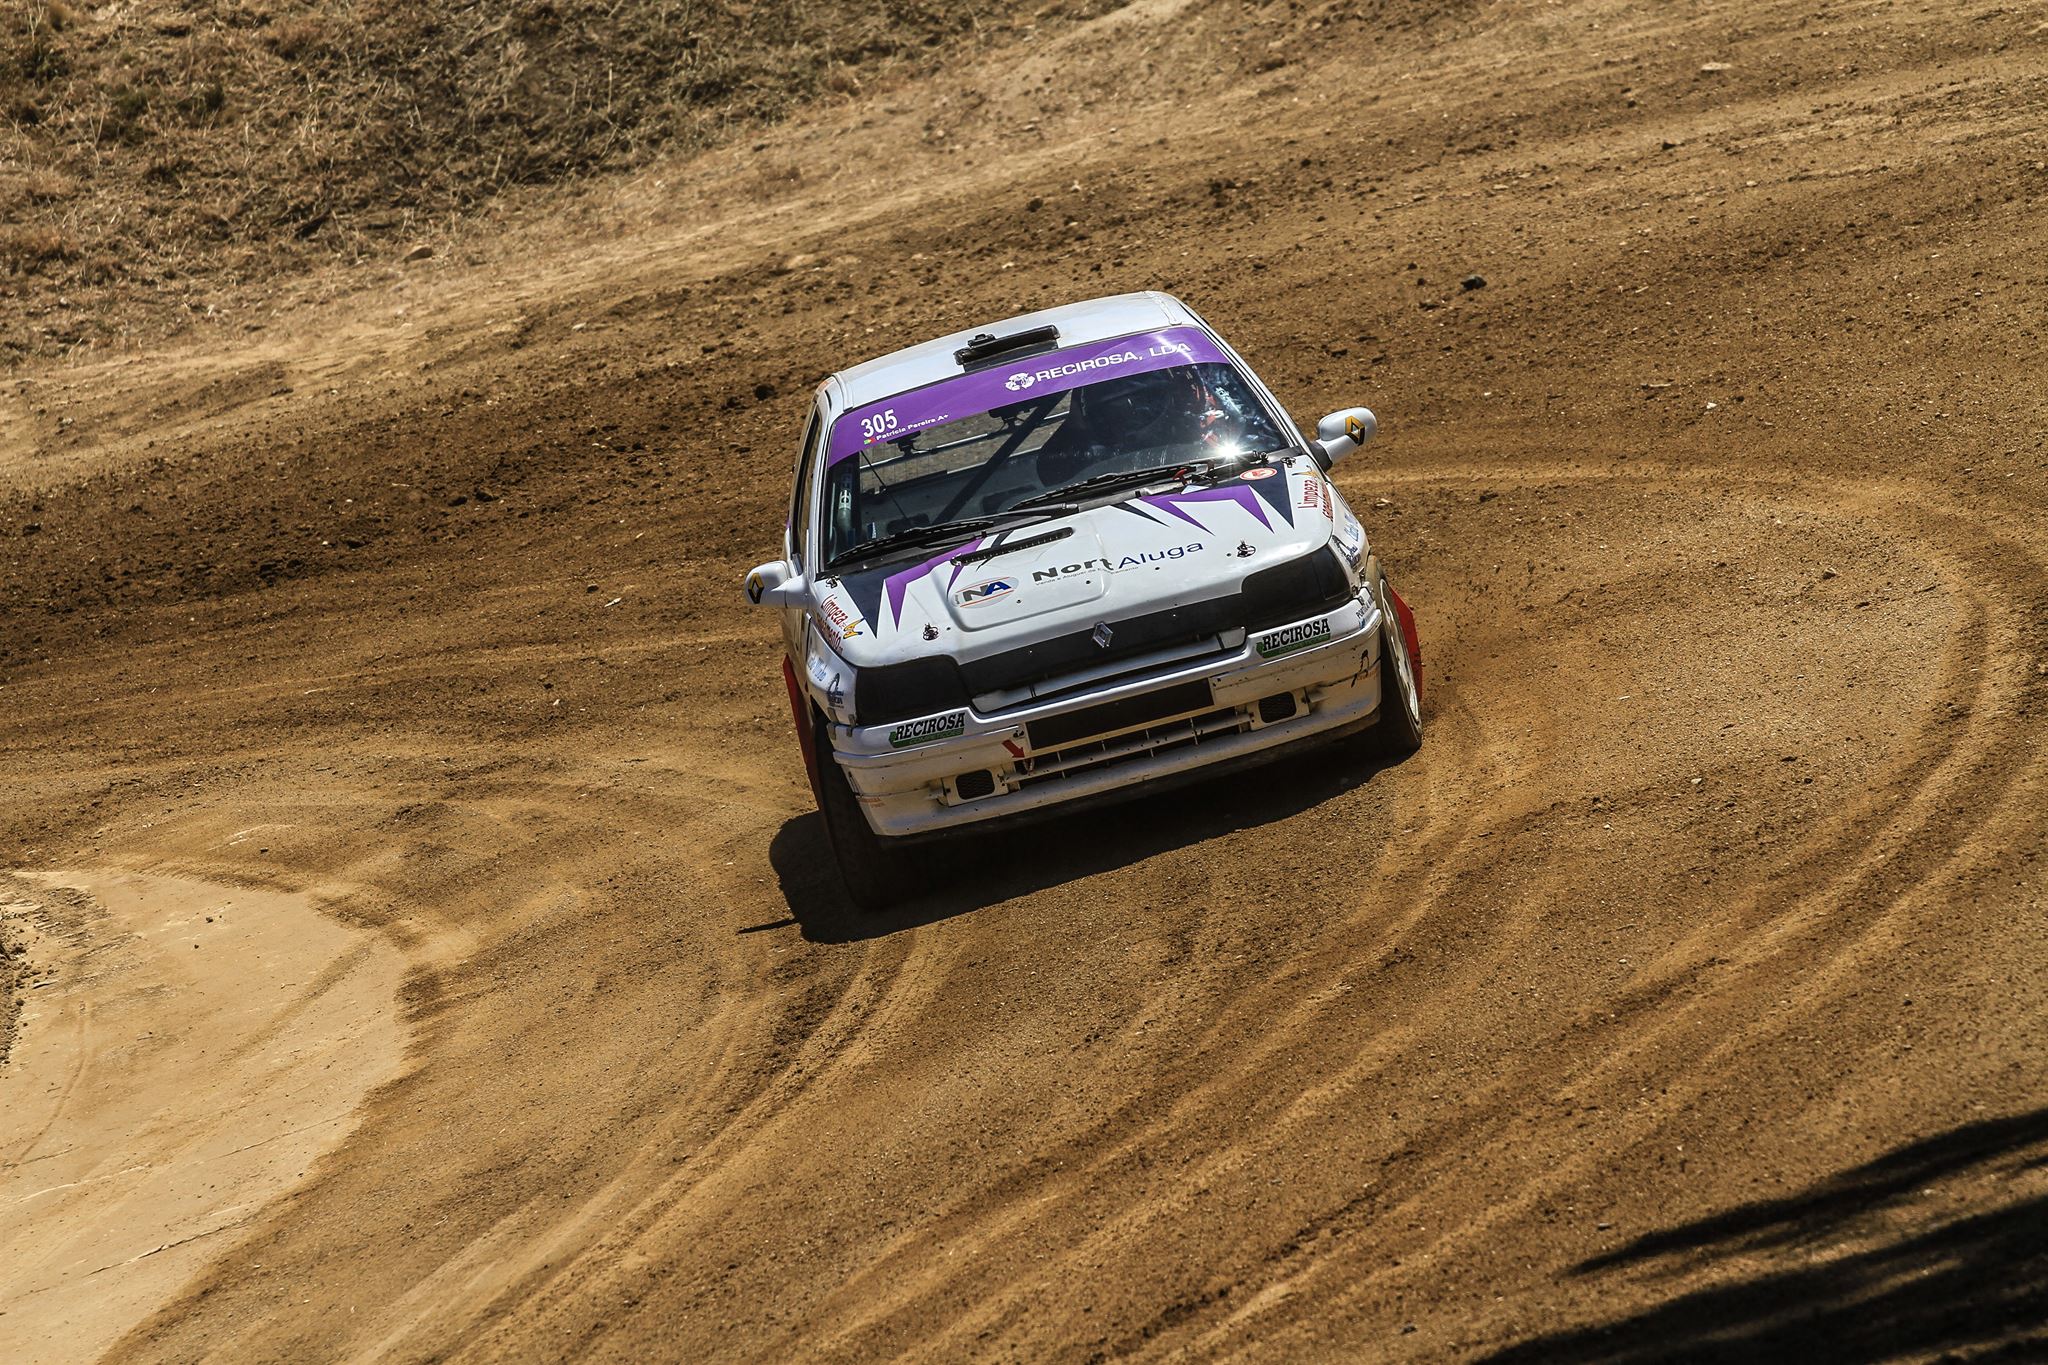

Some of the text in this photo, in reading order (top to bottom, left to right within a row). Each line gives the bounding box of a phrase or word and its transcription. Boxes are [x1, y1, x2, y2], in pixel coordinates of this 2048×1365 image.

[1036, 343, 1192, 382] RECIROSA, LDA
[861, 409, 898, 438] 305
[962, 581, 1012, 602] NA
[821, 594, 848, 627] Limpeza
[1262, 618, 1331, 652] RECIROSA
[895, 712, 965, 741] RECIROSA
